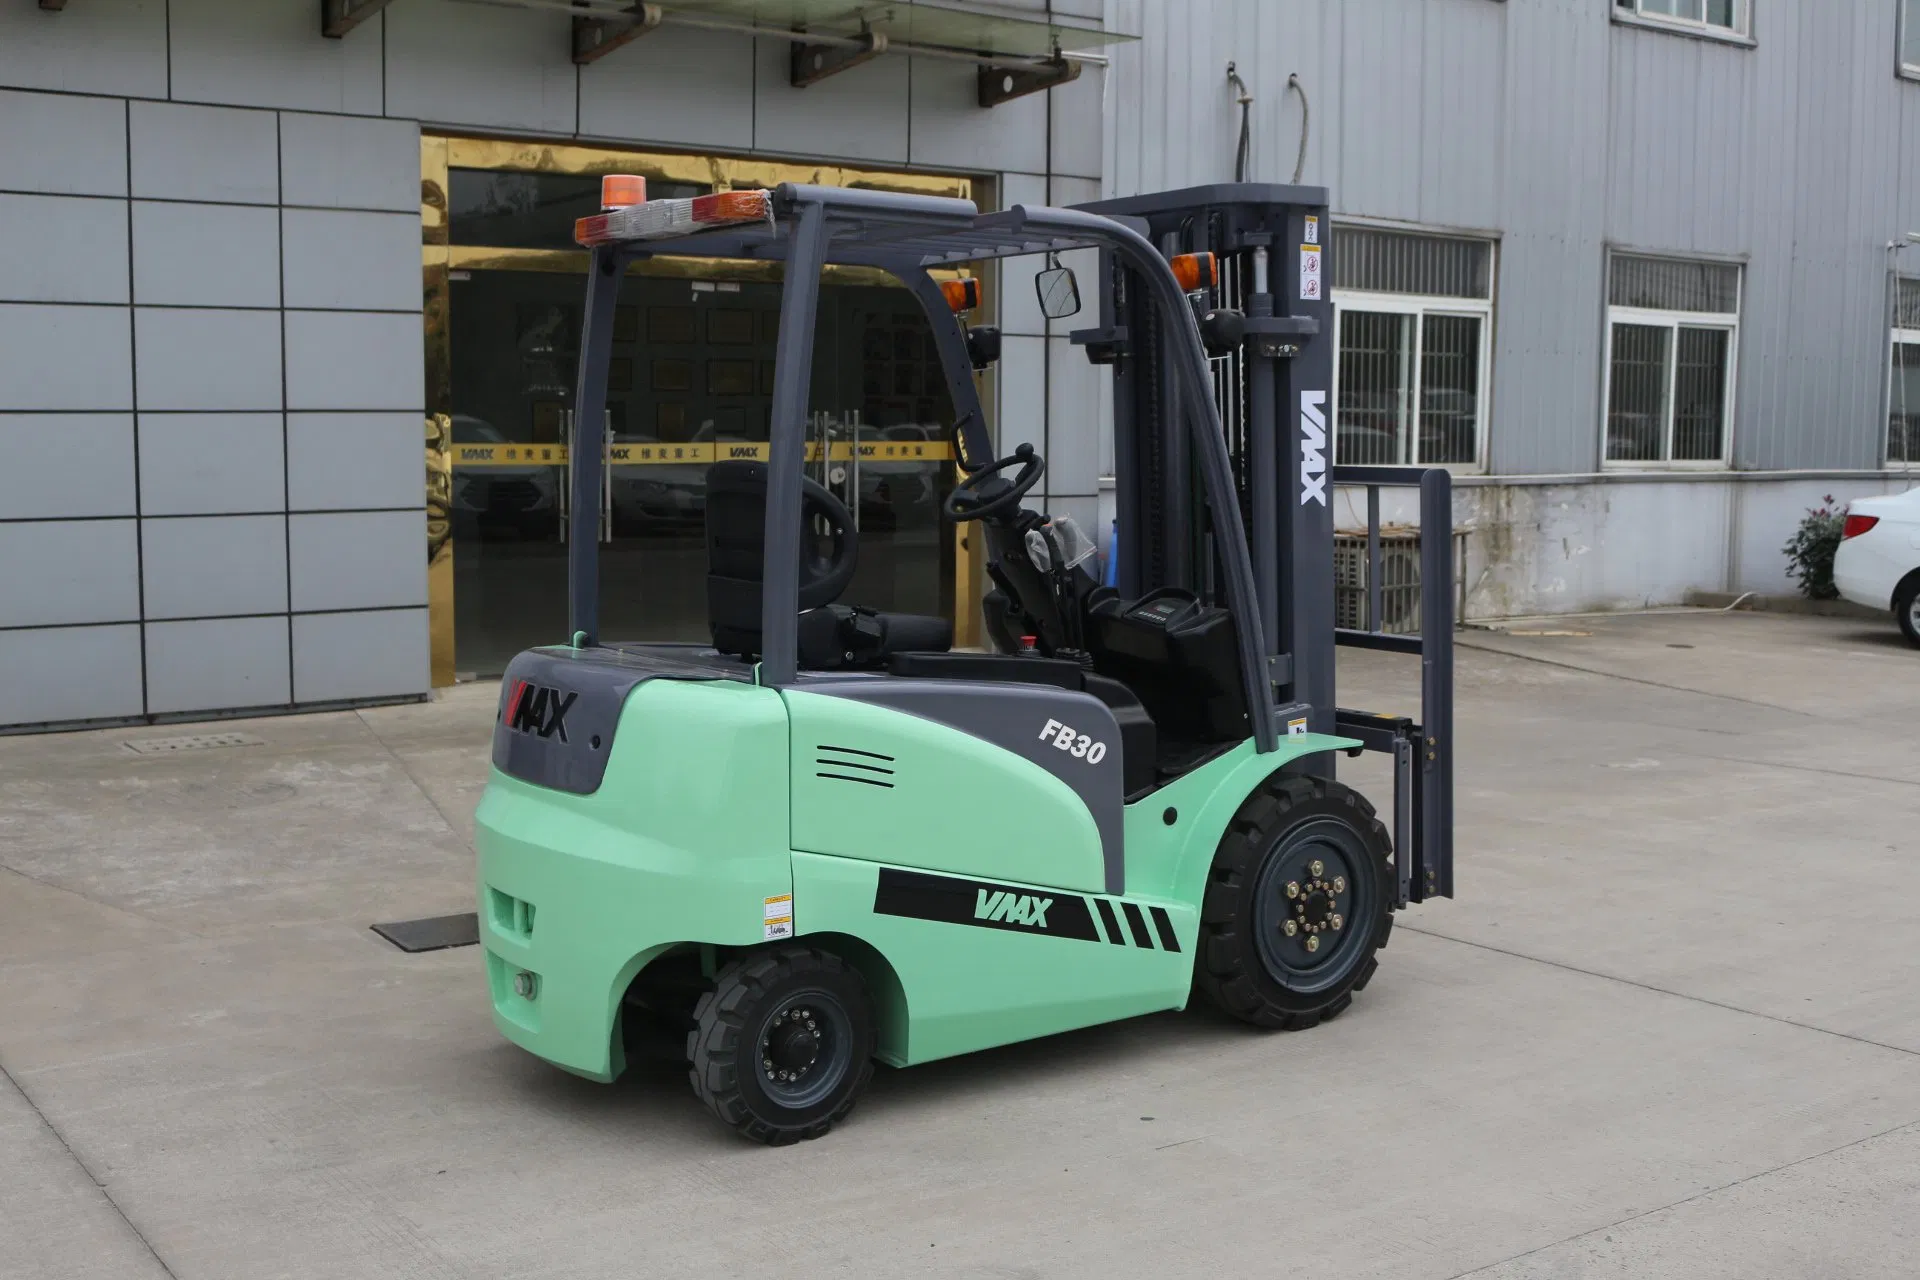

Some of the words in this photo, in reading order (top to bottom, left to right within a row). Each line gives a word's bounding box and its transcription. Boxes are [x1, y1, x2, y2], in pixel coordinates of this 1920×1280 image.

[461, 448, 494, 460] VMAX
[730, 447, 758, 458] VMAX
[1301, 390, 1326, 507] VMAX
[505, 679, 579, 745] VMAX
[1038, 718, 1107, 765] FB30
[974, 888, 1054, 928] VMAX
